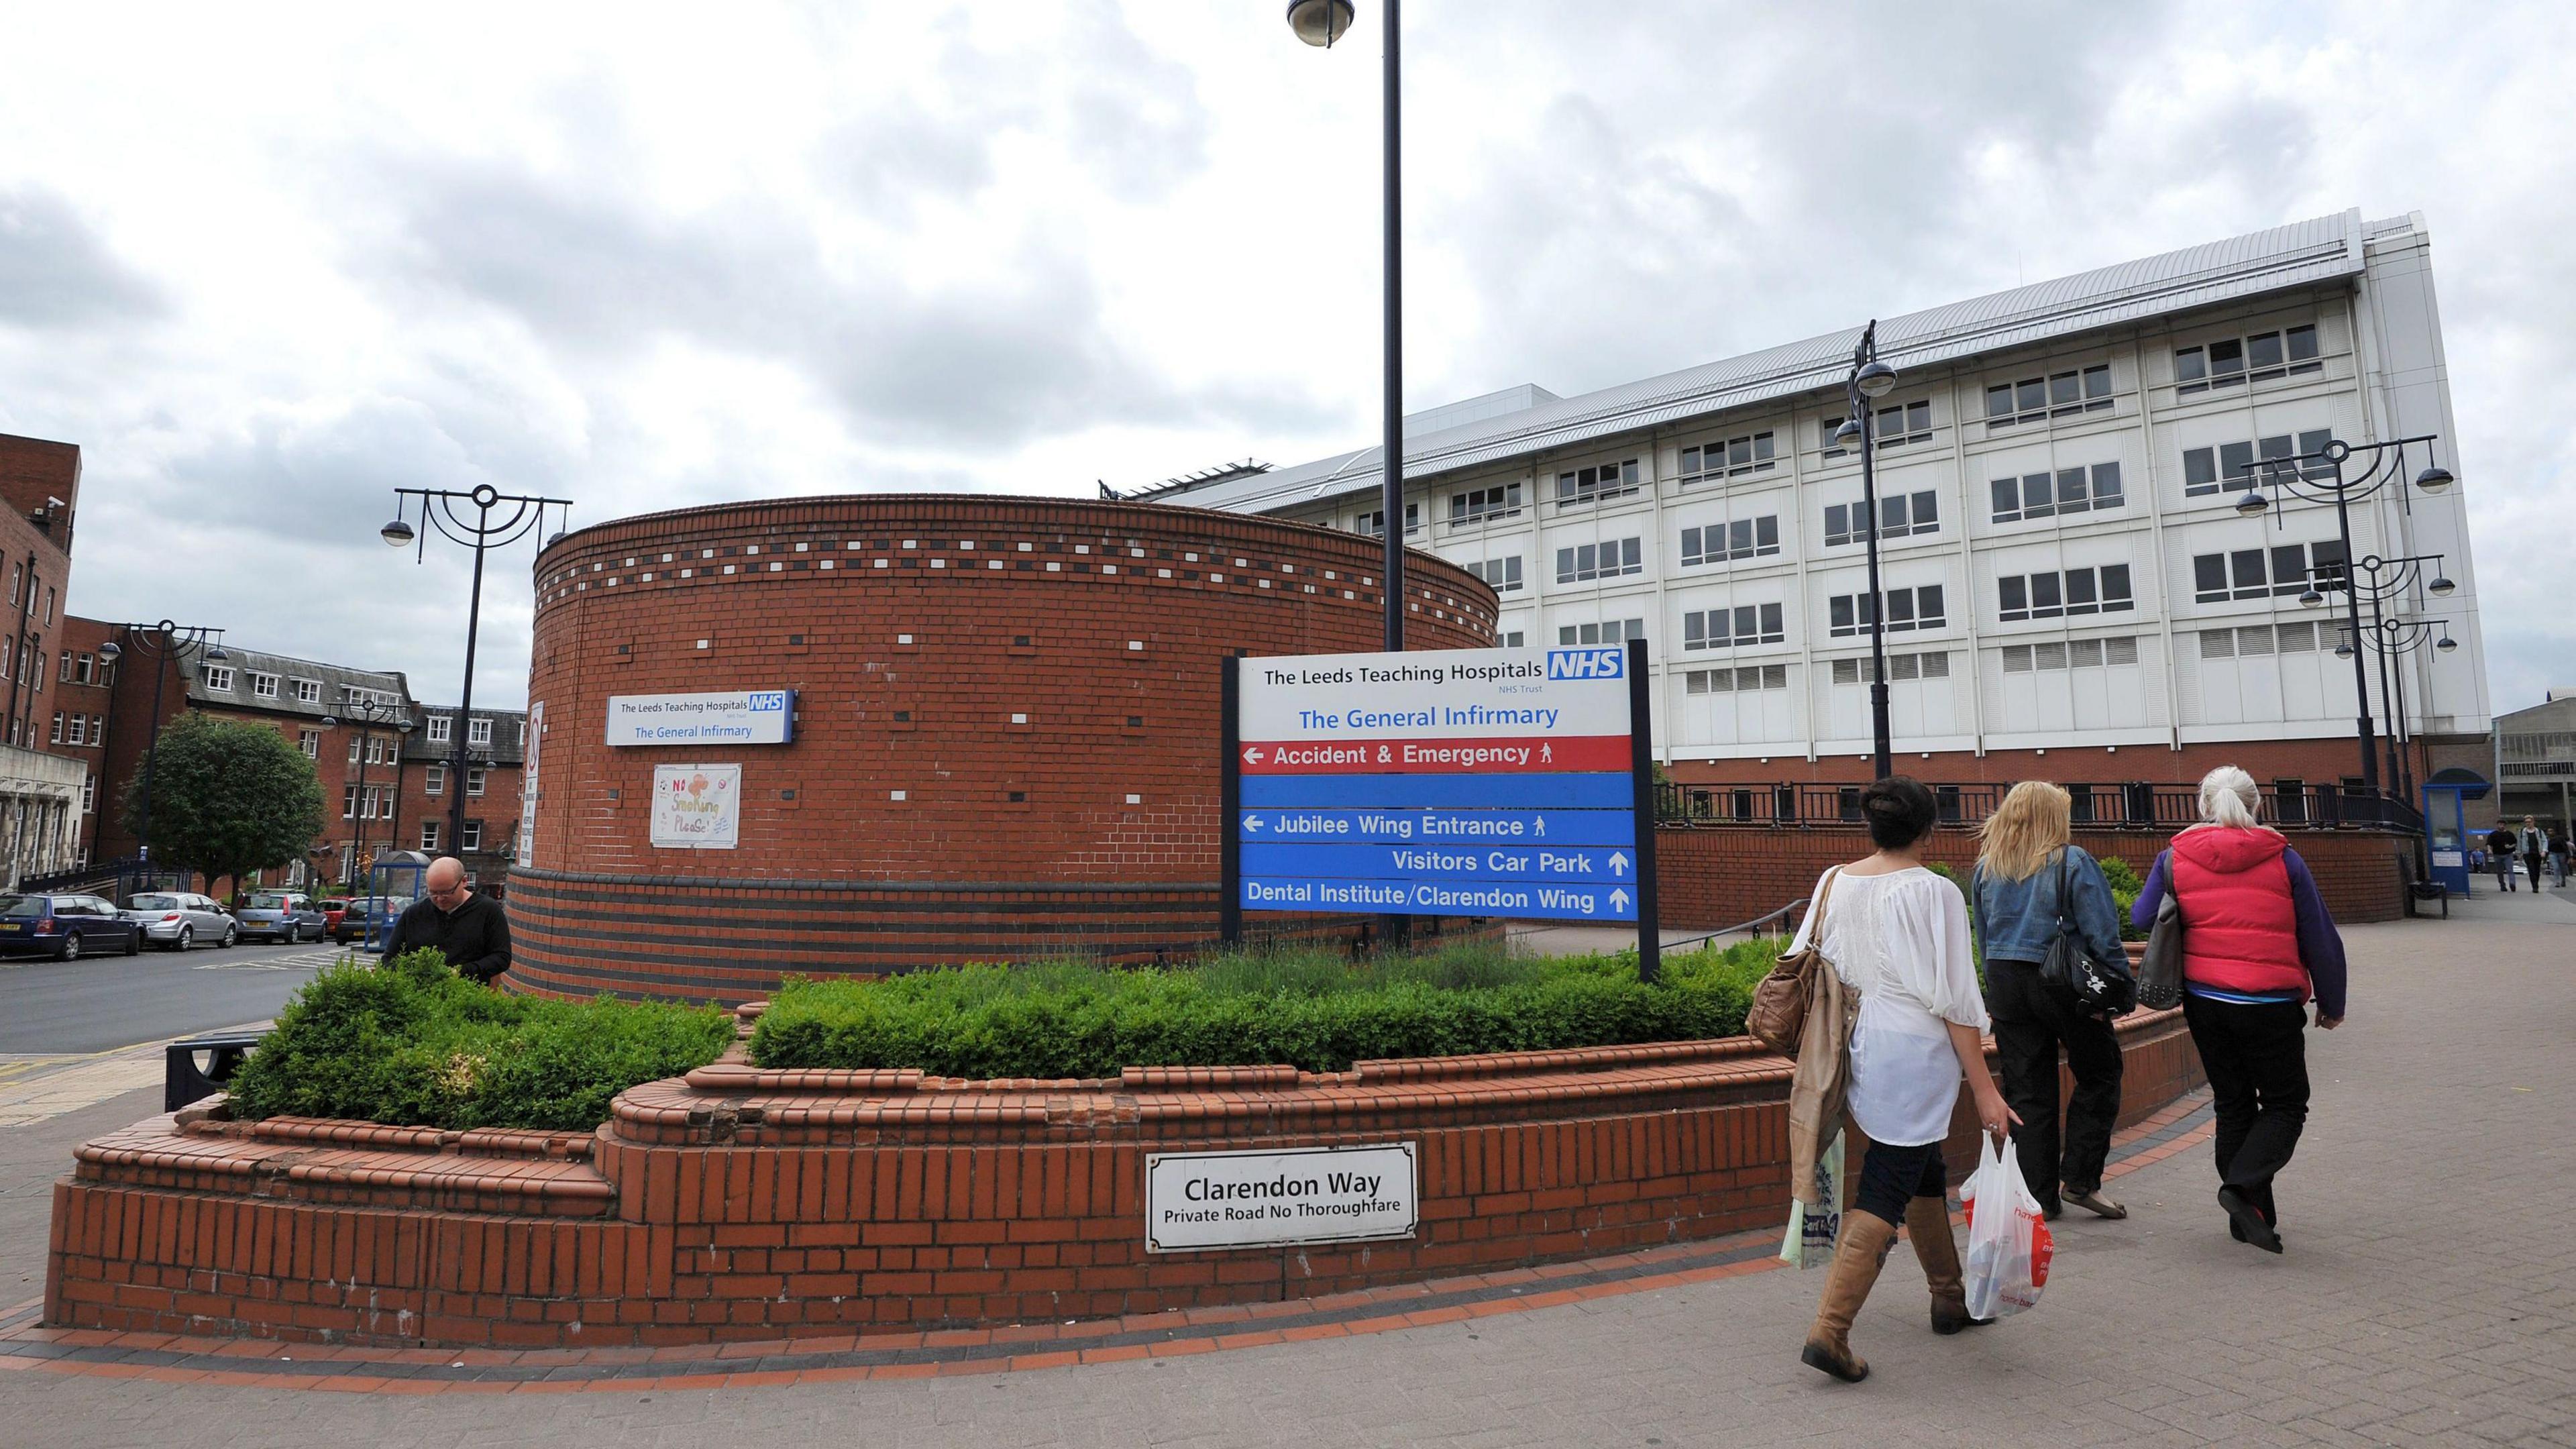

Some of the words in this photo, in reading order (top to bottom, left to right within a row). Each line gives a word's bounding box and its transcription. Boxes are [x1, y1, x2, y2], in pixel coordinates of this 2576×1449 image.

[1265, 669, 1295, 685] The
[1303, 668, 1353, 684] Leeds
[1359, 665, 1443, 684] Teaching
[1452, 661, 1542, 682] Hospitals
[1550, 651, 1619, 678] NHS
[1499, 686, 1517, 694] NHS
[621, 704, 636, 713] The
[639, 702, 663, 712] Leeds
[665, 701, 704, 713] Teaching
[706, 700, 747, 712] Hospitals
[750, 695, 782, 710] NHS
[1299, 710, 1338, 729] The
[1347, 707, 1435, 728] General
[1446, 705, 1559, 729] Infirmary
[635, 727, 653, 738] The
[657, 725, 697, 737] General
[701, 724, 751, 739] Infirmary
[1274, 746, 1366, 765] Accident
[1377, 745, 1392, 763] &
[1403, 745, 1530, 766] Emergency
[673, 779, 686, 792] NO
[1275, 815, 1349, 834] Jubilee
[1358, 816, 1412, 839] Wing
[1422, 816, 1523, 835] Entrance
[1393, 851, 1477, 871] Visitors
[1488, 852, 1529, 871] Car
[1540, 853, 1592, 873] Park
[1248, 882, 1311, 901] Dental
[1320, 883, 1527, 908] Institute/Clarendon
[1538, 889, 1595, 914] Wing
[1185, 1175, 1318, 1201] Clarendon
[1328, 1172, 1381, 1197] Way
[1165, 1209, 1219, 1223] Private
[1225, 1205, 1263, 1221] Road
[1271, 1205, 1291, 1218] No
[1297, 1198, 1401, 1218] Thoroughfare
